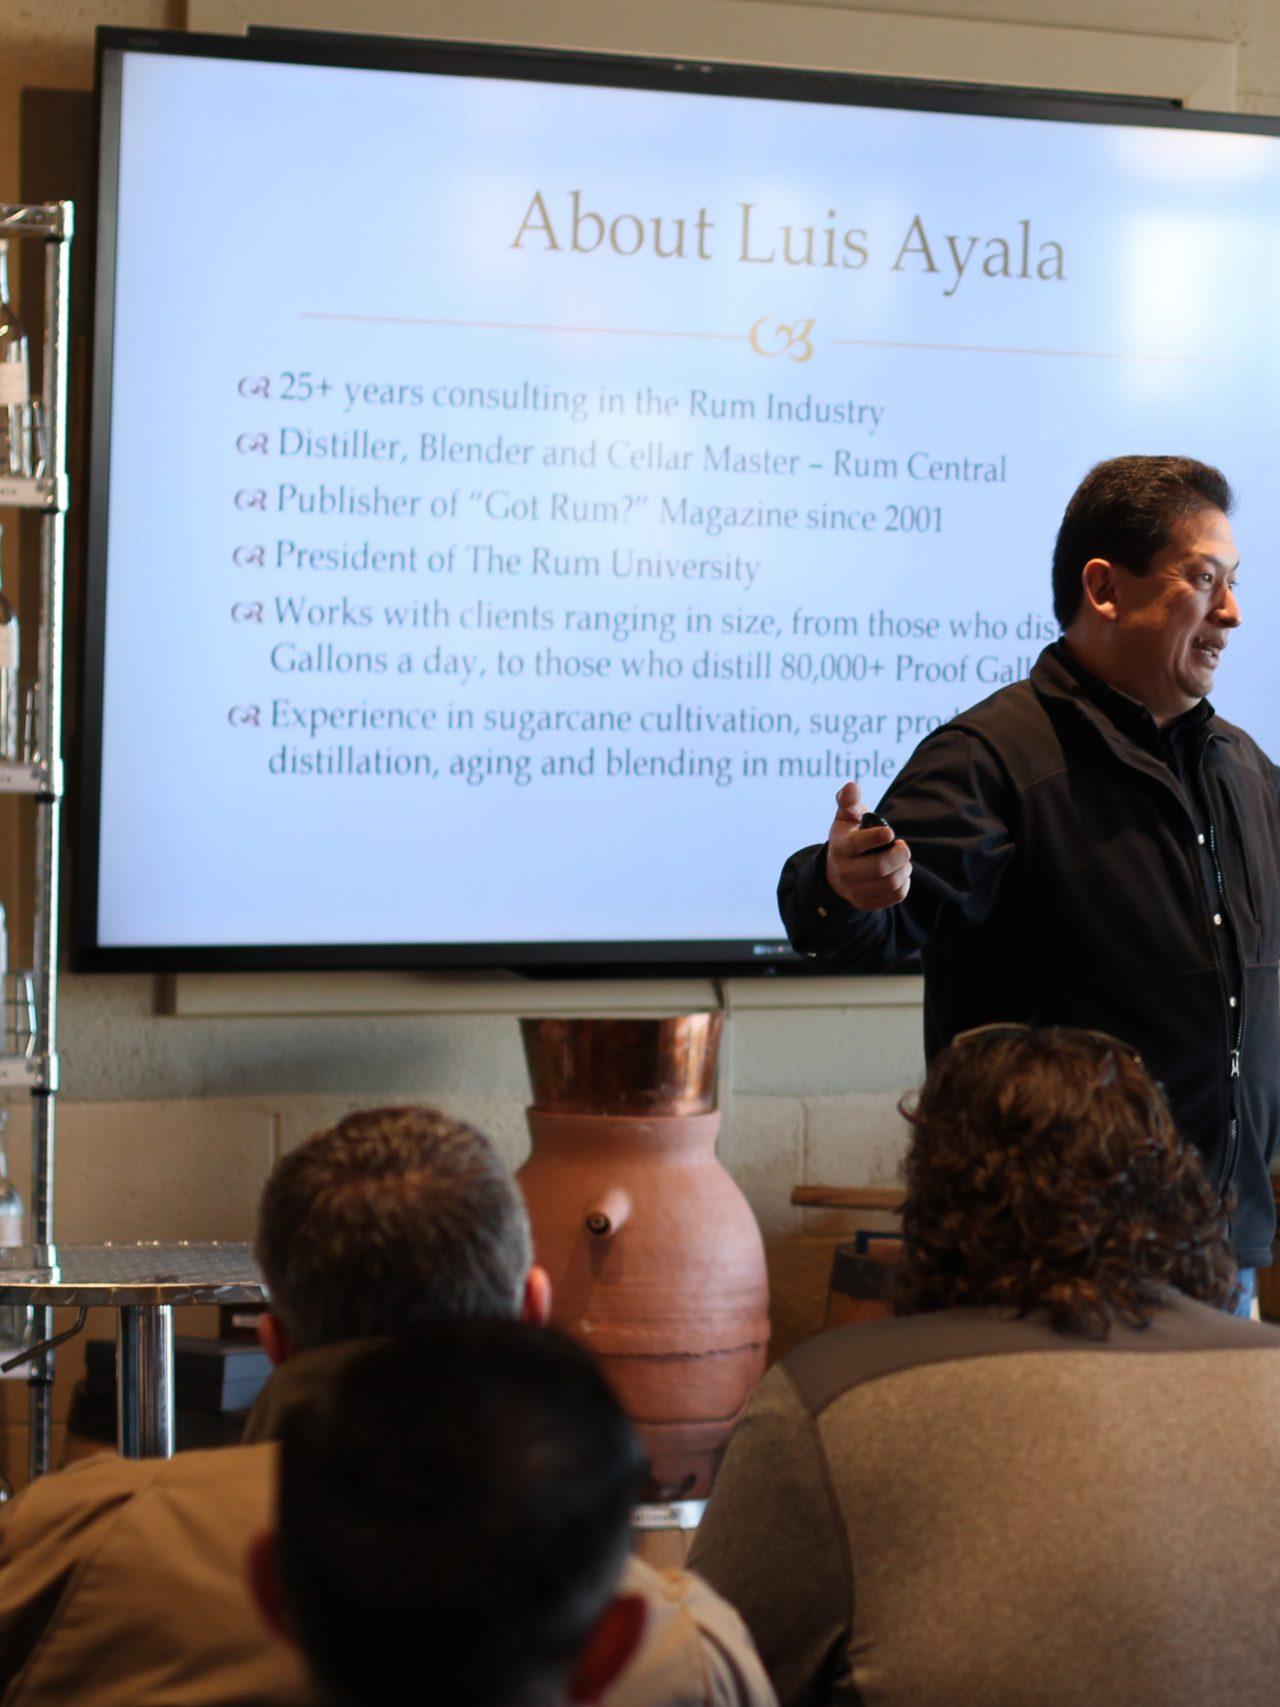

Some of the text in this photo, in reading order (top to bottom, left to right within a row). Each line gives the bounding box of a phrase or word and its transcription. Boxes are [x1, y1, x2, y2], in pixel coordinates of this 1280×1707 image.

[510, 189, 1066, 297] About Luis Ayala
[280, 370, 884, 436] 25+ years consulting in the Rum Industry
[279, 427, 408, 464] Distiller,
[420, 432, 534, 464] Blender
[542, 439, 596, 468] and
[607, 440, 695, 471] Cellar
[704, 444, 800, 475] Master
[834, 449, 898, 479] Rum
[906, 451, 1006, 482] Central
[278, 483, 421, 516] Publisher
[430, 488, 460, 517] of
[662, 496, 800, 537] Magazine
[806, 504, 877, 531] since
[884, 504, 942, 533] 2001
[276, 539, 760, 593] President of The Rum University
[274, 596, 1060, 643] Works with clients ranging in size, from those who dis
[271, 643, 1031, 686] Gallons a day, to those who distill 80,000+ Proof Gall
[271, 699, 960, 744] Experience in sugarcane cultivation, sugar pro
[268, 744, 895, 787] distillation, aging and blending in multiple
